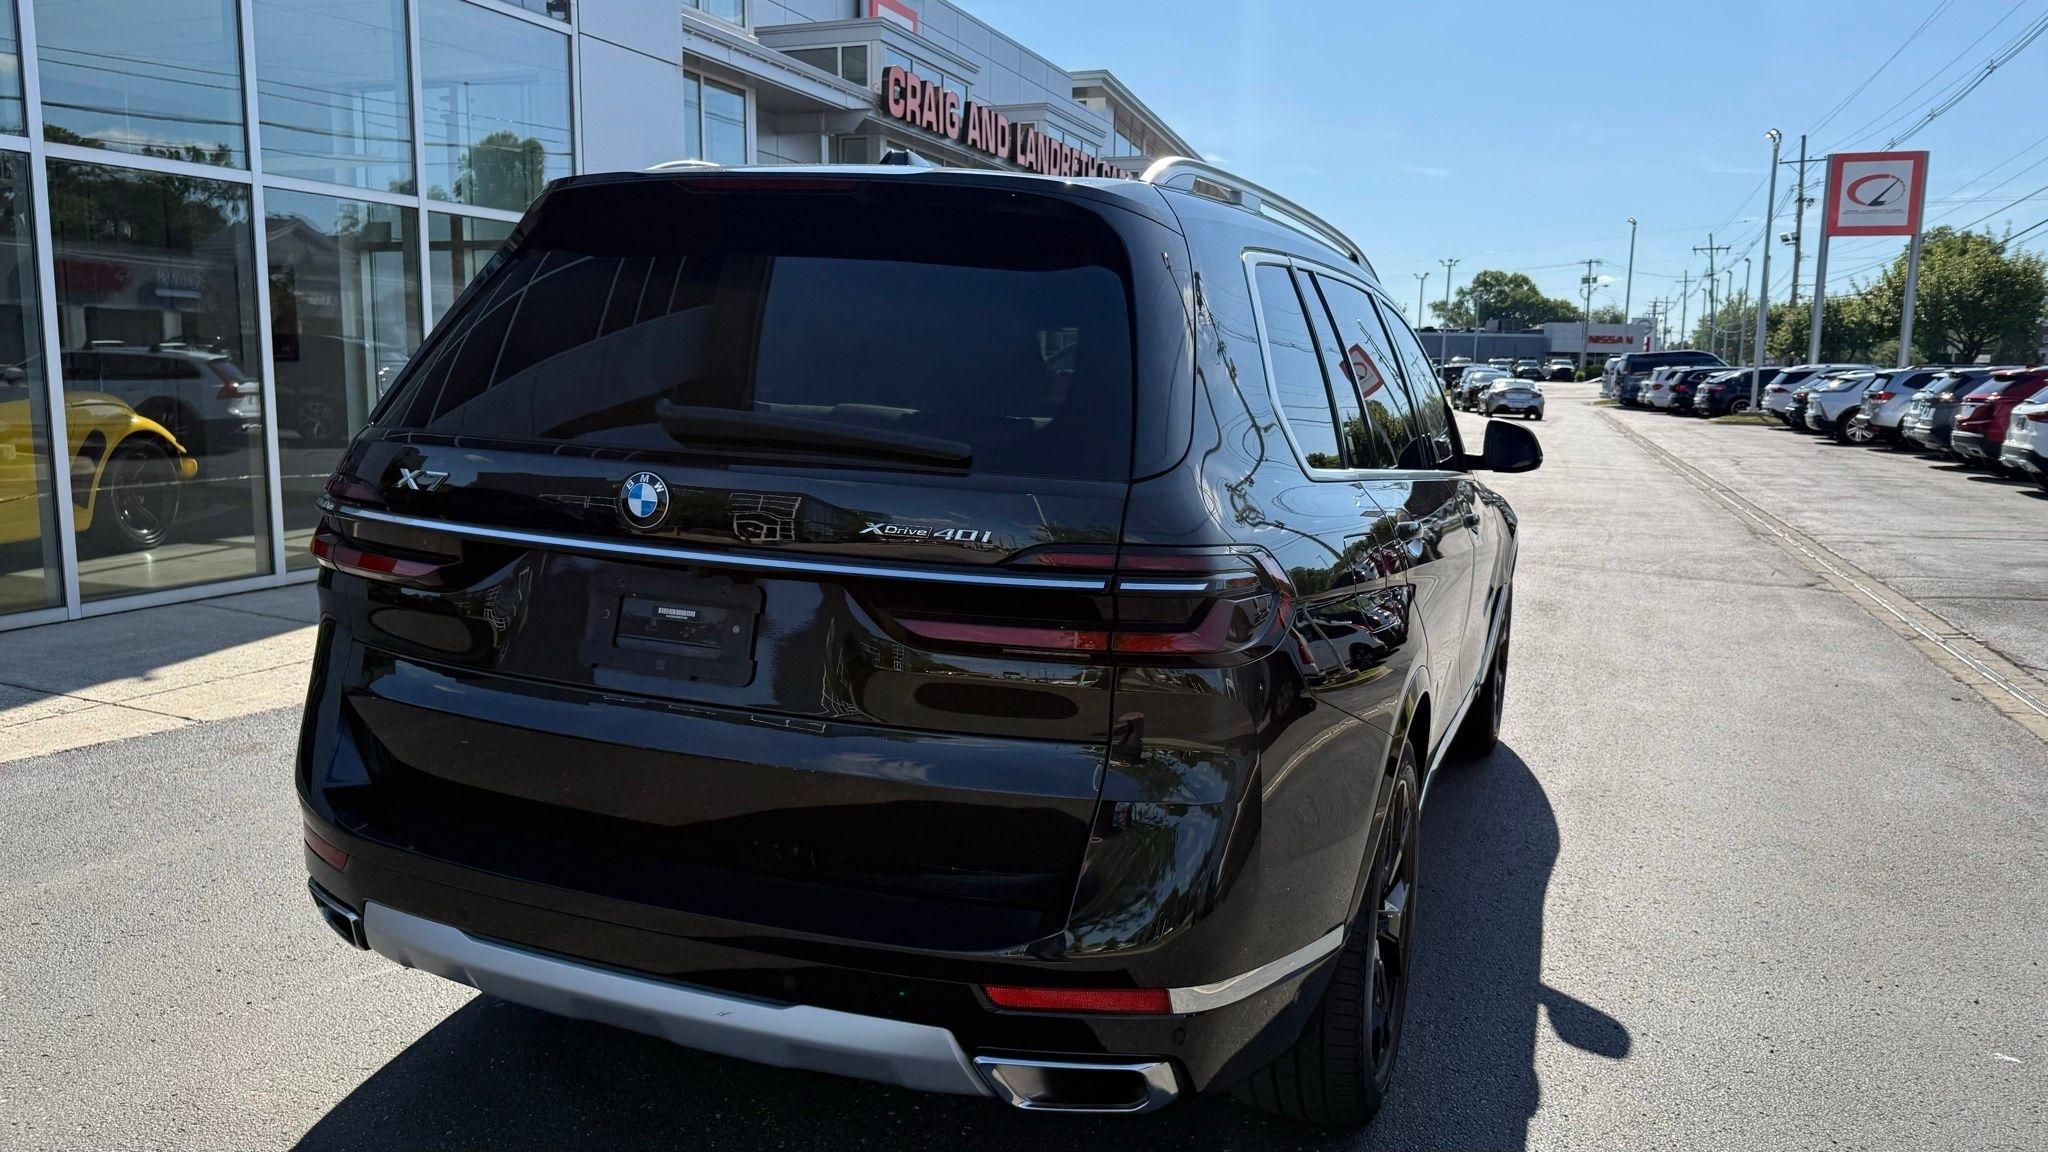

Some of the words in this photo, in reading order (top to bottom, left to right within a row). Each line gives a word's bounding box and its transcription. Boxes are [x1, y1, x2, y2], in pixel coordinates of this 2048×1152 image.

[886, 65, 960, 140] CRAIG
[966, 101, 1009, 159] AND
[1016, 122, 1097, 178] LANDRETH
[1588, 335, 1634, 345] NISSAN
[396, 468, 449, 491] X7
[626, 474, 665, 493] BMW
